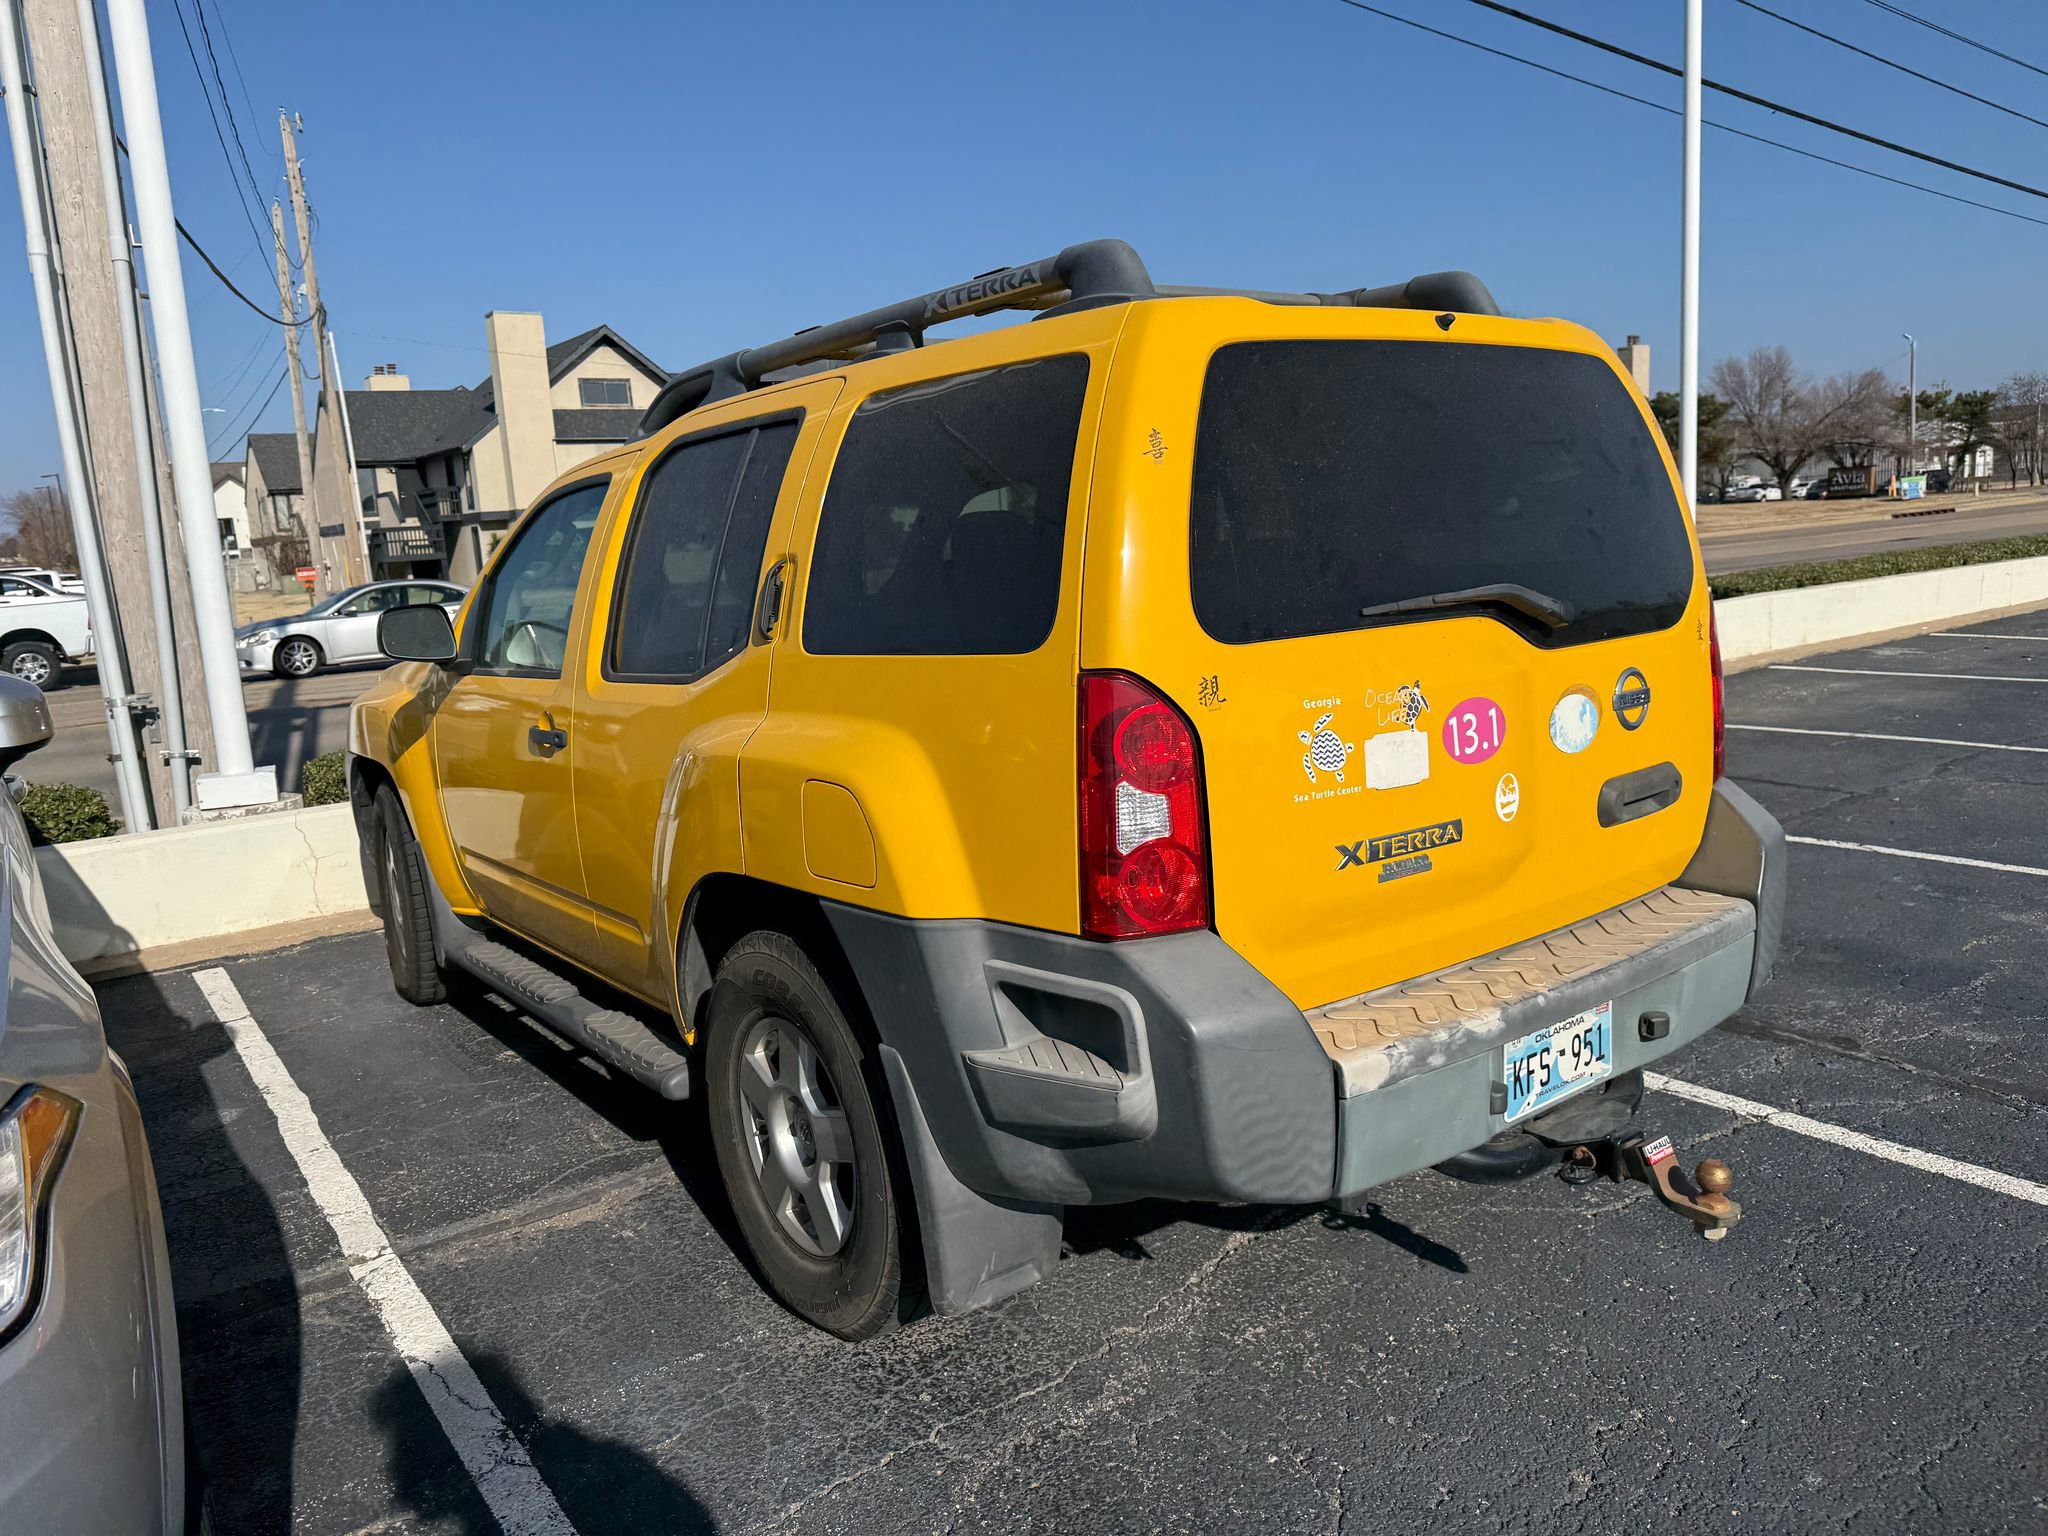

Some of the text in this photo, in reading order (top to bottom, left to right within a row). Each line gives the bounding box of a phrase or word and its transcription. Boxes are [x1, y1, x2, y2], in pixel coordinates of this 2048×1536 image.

[923, 264, 1040, 318] XTERRA
[1832, 471, 1865, 484] Avia
[1303, 696, 1341, 709] Georgia
[1447, 707, 1500, 757] 13.1
[1294, 785, 1362, 803] Sea Turtle Center
[1335, 819, 1462, 871] XTERRA
[1535, 1016, 1585, 1043] OKLAHOMA
[1535, 1071, 1586, 1098] TRAVELOK.COM
